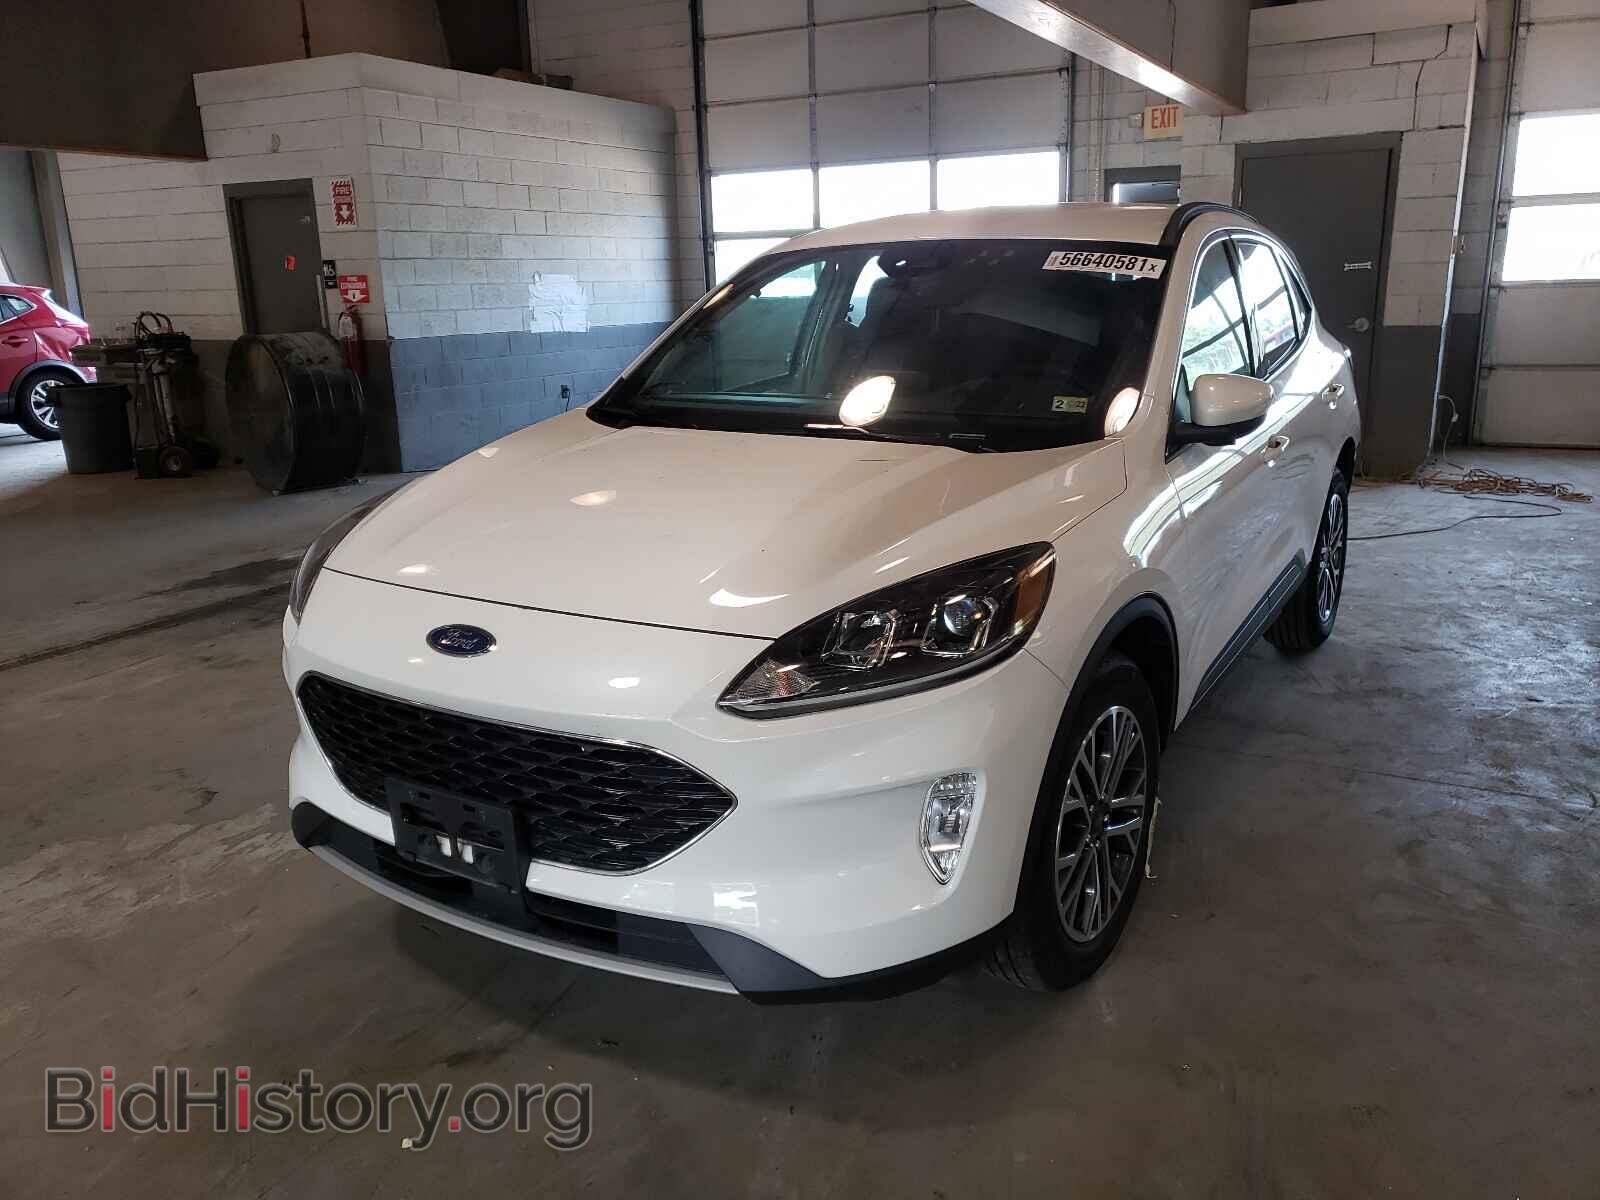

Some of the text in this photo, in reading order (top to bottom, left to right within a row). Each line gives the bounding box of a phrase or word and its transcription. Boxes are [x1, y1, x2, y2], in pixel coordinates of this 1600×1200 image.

[1151, 106, 1178, 129] EXIT
[1059, 252, 1148, 272] 56640581
[1055, 399, 1065, 409] 2
